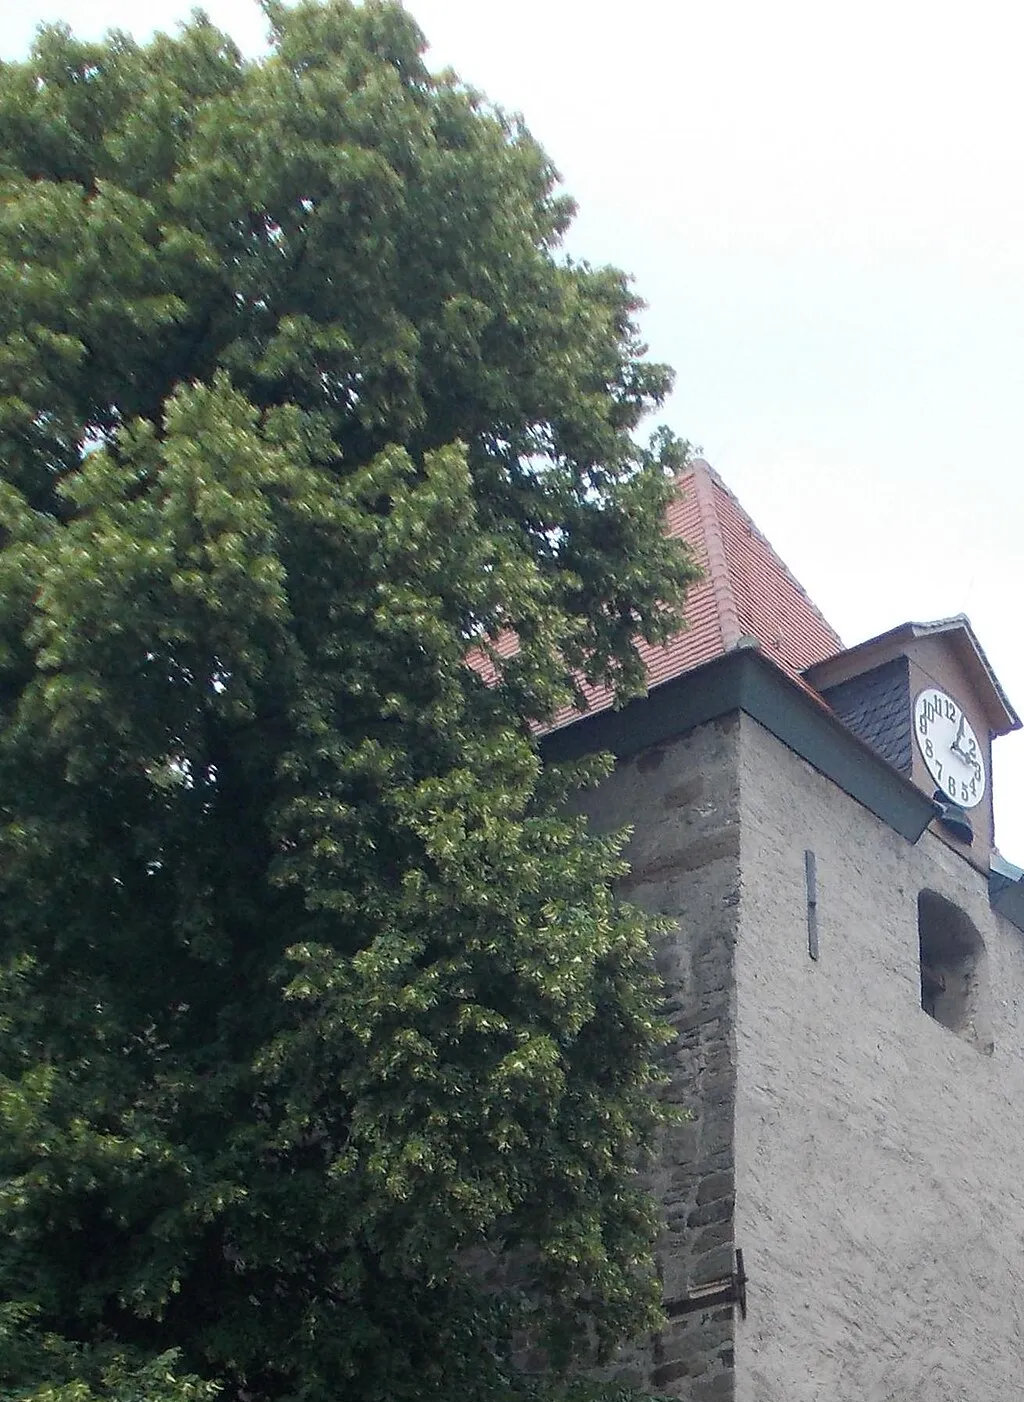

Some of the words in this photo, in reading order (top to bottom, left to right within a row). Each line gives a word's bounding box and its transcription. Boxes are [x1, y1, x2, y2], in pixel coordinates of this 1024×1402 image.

[922, 699, 934, 723] 10
[934, 695, 942, 718] 11
[944, 699, 956, 723] 12
[925, 738, 933, 758] 8
[969, 738, 977, 759] 2
[935, 760, 943, 782] 7
[961, 783, 969, 801] 5
[969, 777, 977, 797] 4
